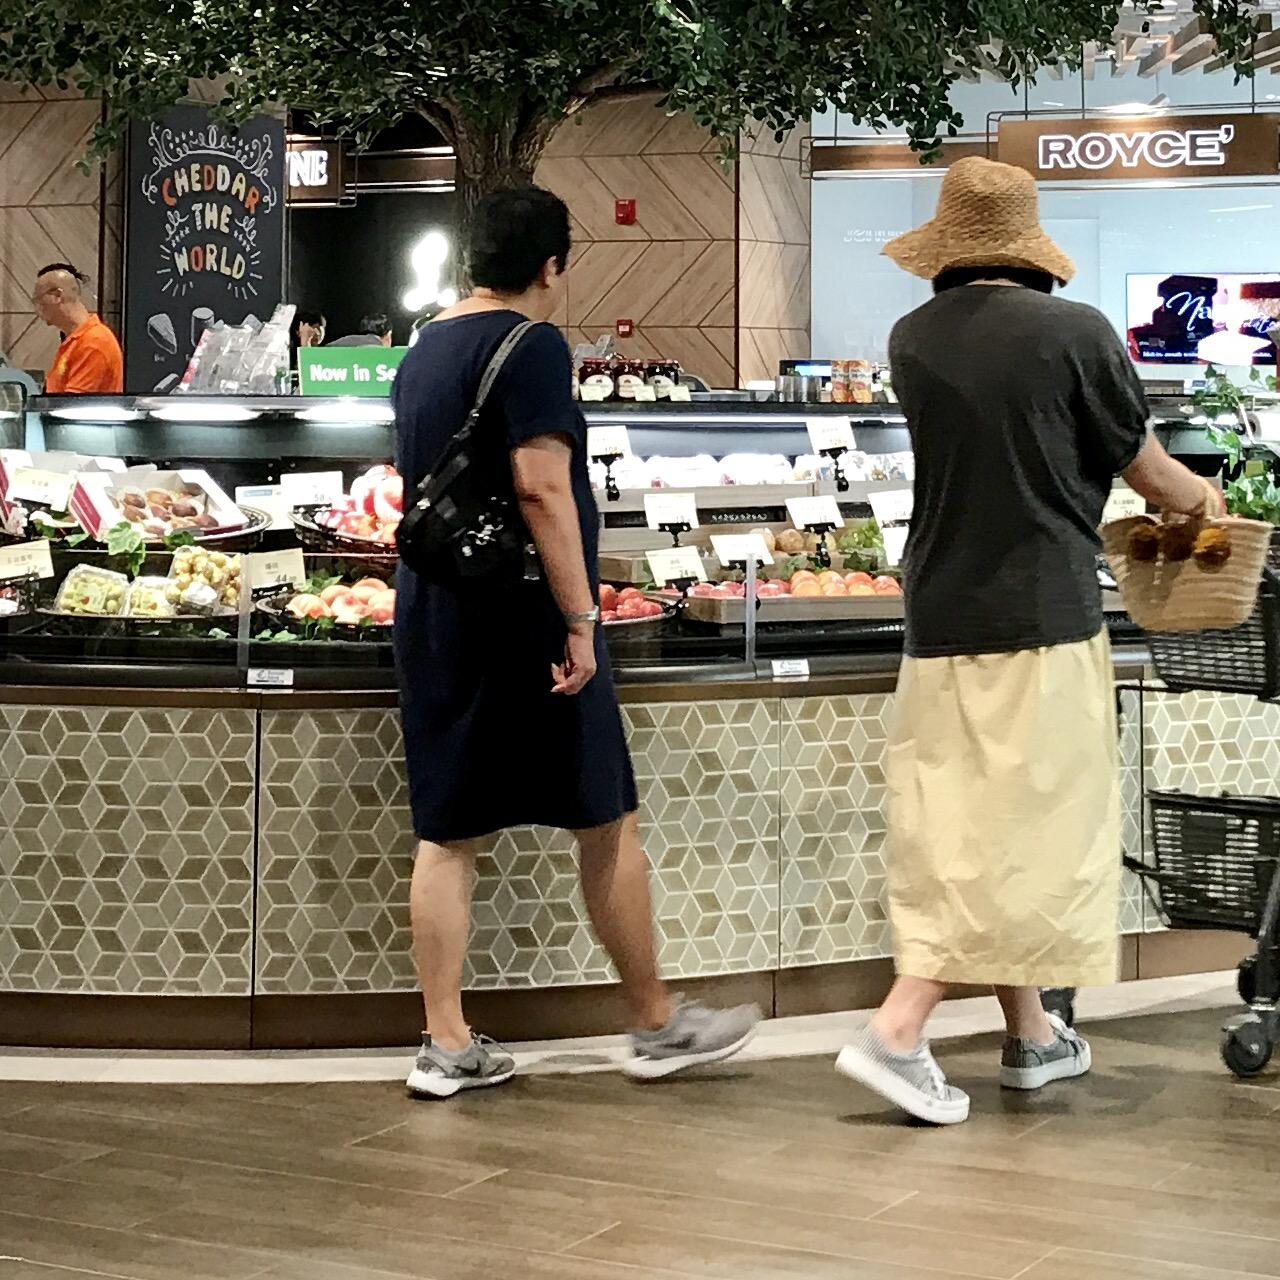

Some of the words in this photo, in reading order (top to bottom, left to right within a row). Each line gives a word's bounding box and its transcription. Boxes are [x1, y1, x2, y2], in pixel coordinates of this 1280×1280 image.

[1038, 120, 1234, 170] ROYCE'
[162, 163, 260, 215] CHEDDAR
[191, 202, 233, 234] THE
[173, 243, 246, 280] WORLD
[309, 363, 347, 382] Now
[352, 363, 371, 382] in
